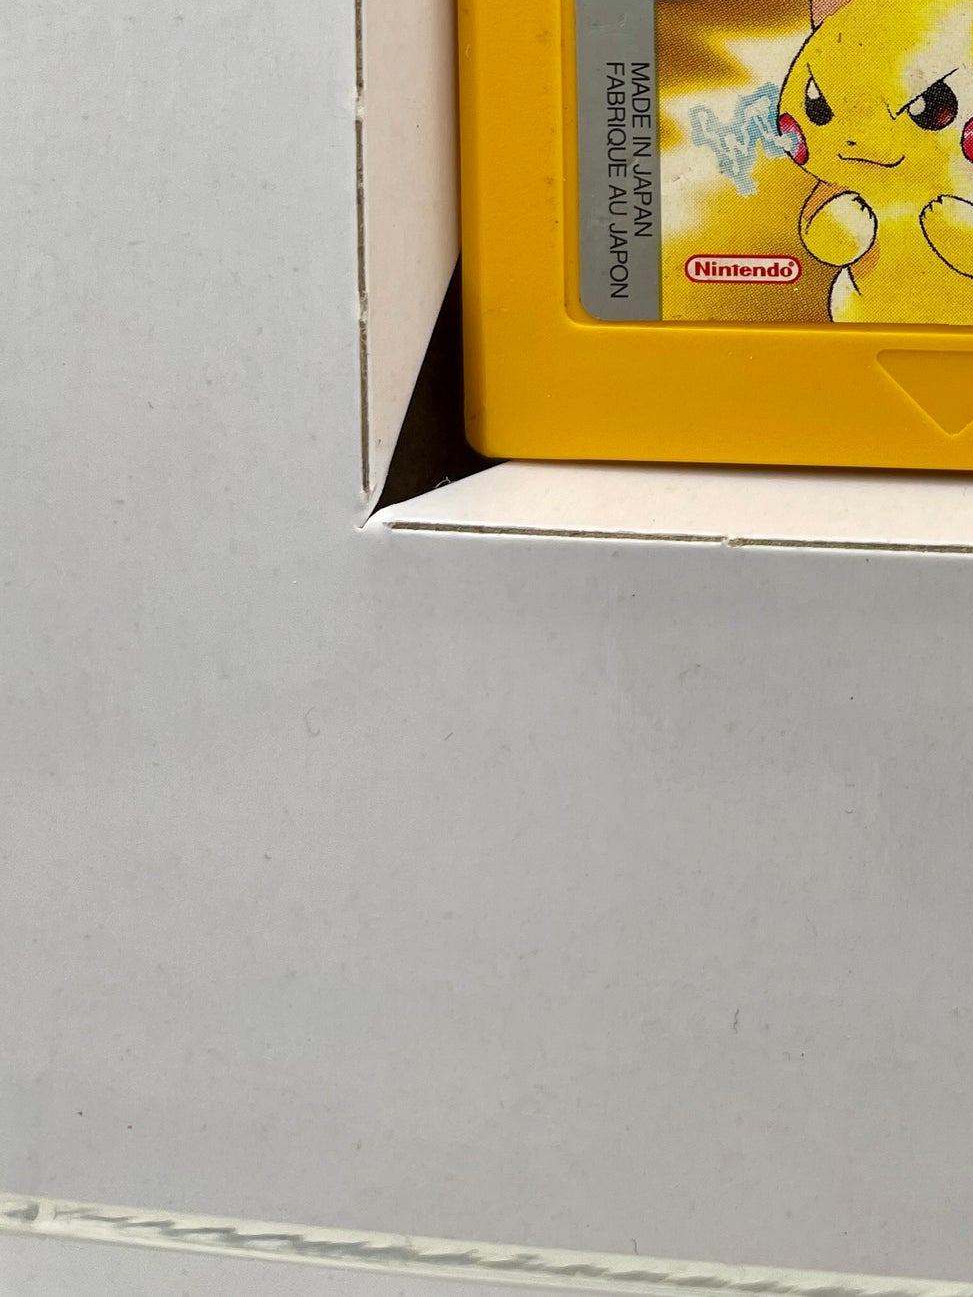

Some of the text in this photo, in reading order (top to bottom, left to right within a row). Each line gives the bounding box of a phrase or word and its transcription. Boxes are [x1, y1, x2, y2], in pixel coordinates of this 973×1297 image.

[606, 62, 629, 298] FABRIQUE AU JAPON
[631, 62, 653, 237] MADE IN JAPAN
